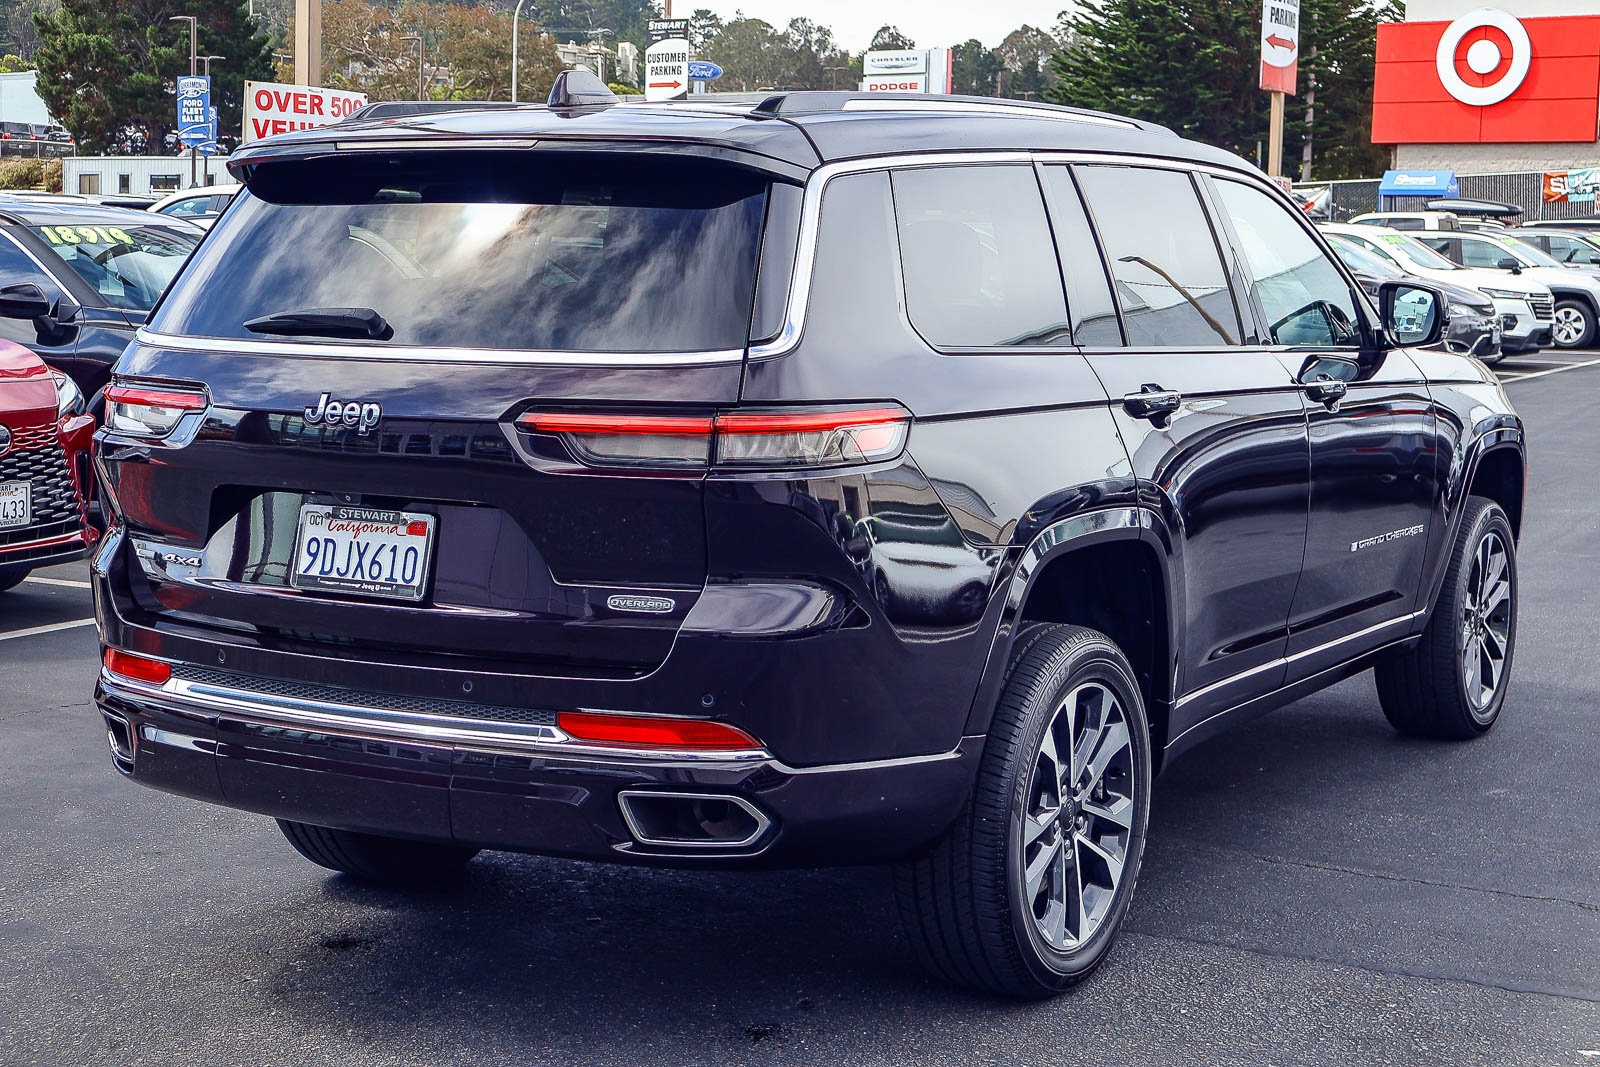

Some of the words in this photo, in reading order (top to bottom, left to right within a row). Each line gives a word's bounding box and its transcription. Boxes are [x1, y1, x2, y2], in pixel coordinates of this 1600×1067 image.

[648, 21, 686, 30] STEWART
[647, 52, 687, 63] CUSTOMER
[650, 65, 682, 76] PARKING
[689, 64, 714, 77] Ford
[869, 82, 918, 91] DODGE
[183, 99, 203, 107] FORD
[255, 89, 324, 116] OVER
[182, 107, 205, 115] FLEET
[181, 115, 205, 123] SALES
[303, 391, 381, 434] Jeep
[0, 499, 26, 520] 433
[339, 508, 396, 521] STEWART
[327, 519, 407, 539] California
[1358, 534, 1386, 549] GRAND
[1386, 524, 1424, 541] CHEROKEE
[163, 553, 202, 567] 4x4
[302, 536, 419, 585] 9DJX610
[610, 598, 671, 609] OVERLAND
